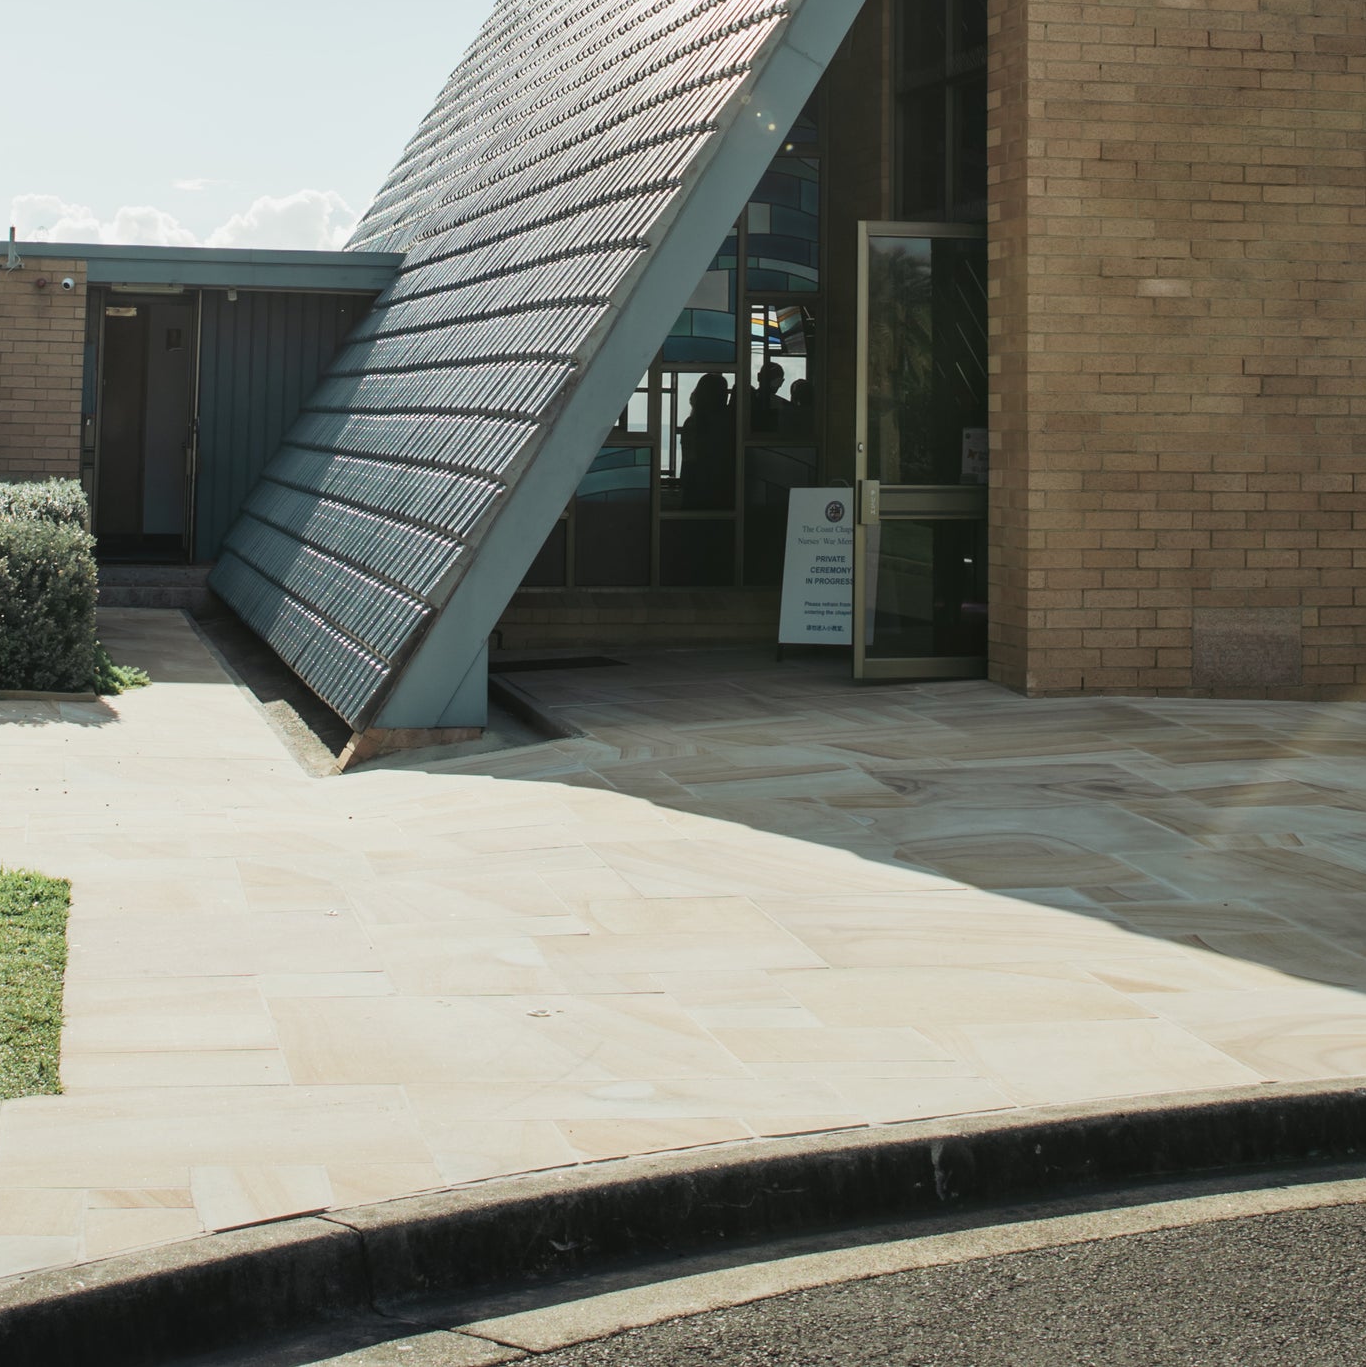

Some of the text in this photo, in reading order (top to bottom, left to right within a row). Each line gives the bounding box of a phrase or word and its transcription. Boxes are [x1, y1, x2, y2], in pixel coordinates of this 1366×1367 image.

[802, 525, 814, 533] The
[815, 525, 834, 533] Coast
[823, 537, 836, 545] War
[815, 555, 846, 563] PRIVATE
[810, 566, 852, 574] CEREMONY
[805, 577, 813, 585] IN
